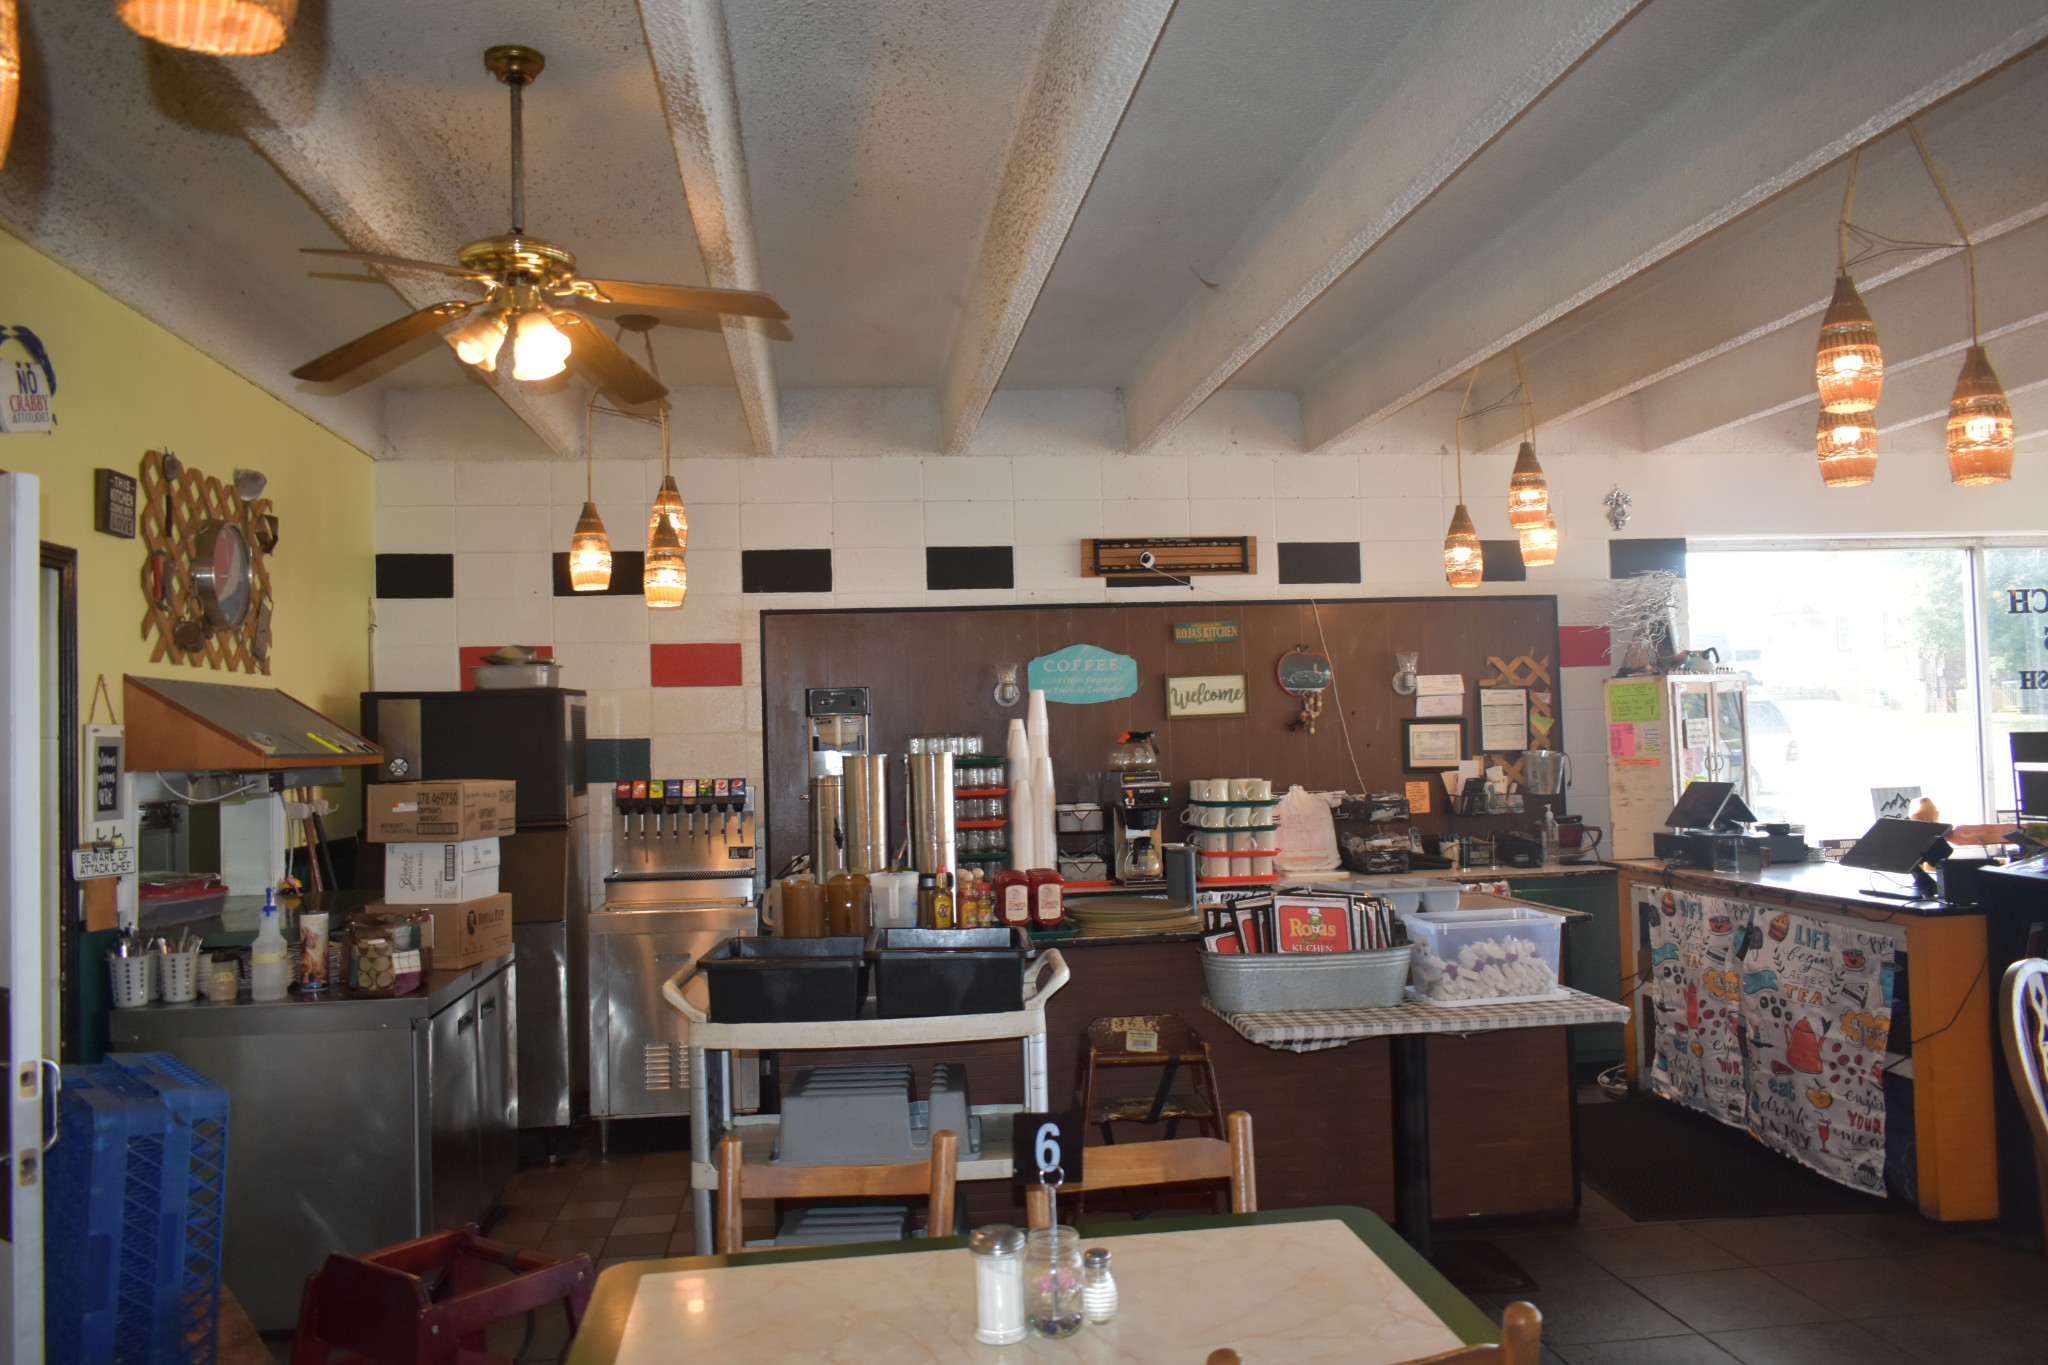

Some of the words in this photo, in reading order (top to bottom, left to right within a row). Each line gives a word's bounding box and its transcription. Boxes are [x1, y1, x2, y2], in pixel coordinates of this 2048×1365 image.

[16, 369, 38, 394] NO
[10, 394, 49, 412] CRABBY
[13, 412, 50, 423] ATTITUDES
[114, 476, 131, 491] THIS
[111, 488, 134, 507] KITCHEN
[111, 512, 134, 535] LOVE
[1176, 627, 1202, 639] ROJAS
[1203, 626, 1238, 638] KITCHEN
[1171, 683, 1243, 709] Welcome
[431, 792, 458, 806] 469750
[80, 863, 110, 875] ATTACK
[112, 861, 131, 872] CHEF
[81, 852, 115, 864] BEWARE
[118, 851, 128, 861] OF
[1795, 924, 1831, 952] LIFE
[1785, 946, 1835, 972] begins
[1784, 970, 1827, 987] AFTER
[1784, 983, 1824, 1006] TEA
[1768, 1078, 1796, 1101] eat
[1760, 1096, 1815, 1132] drink
[1846, 1109, 1882, 1135] YOUR
[1760, 1115, 1812, 1149] ENJOY
[1035, 1122, 1061, 1173] 6
